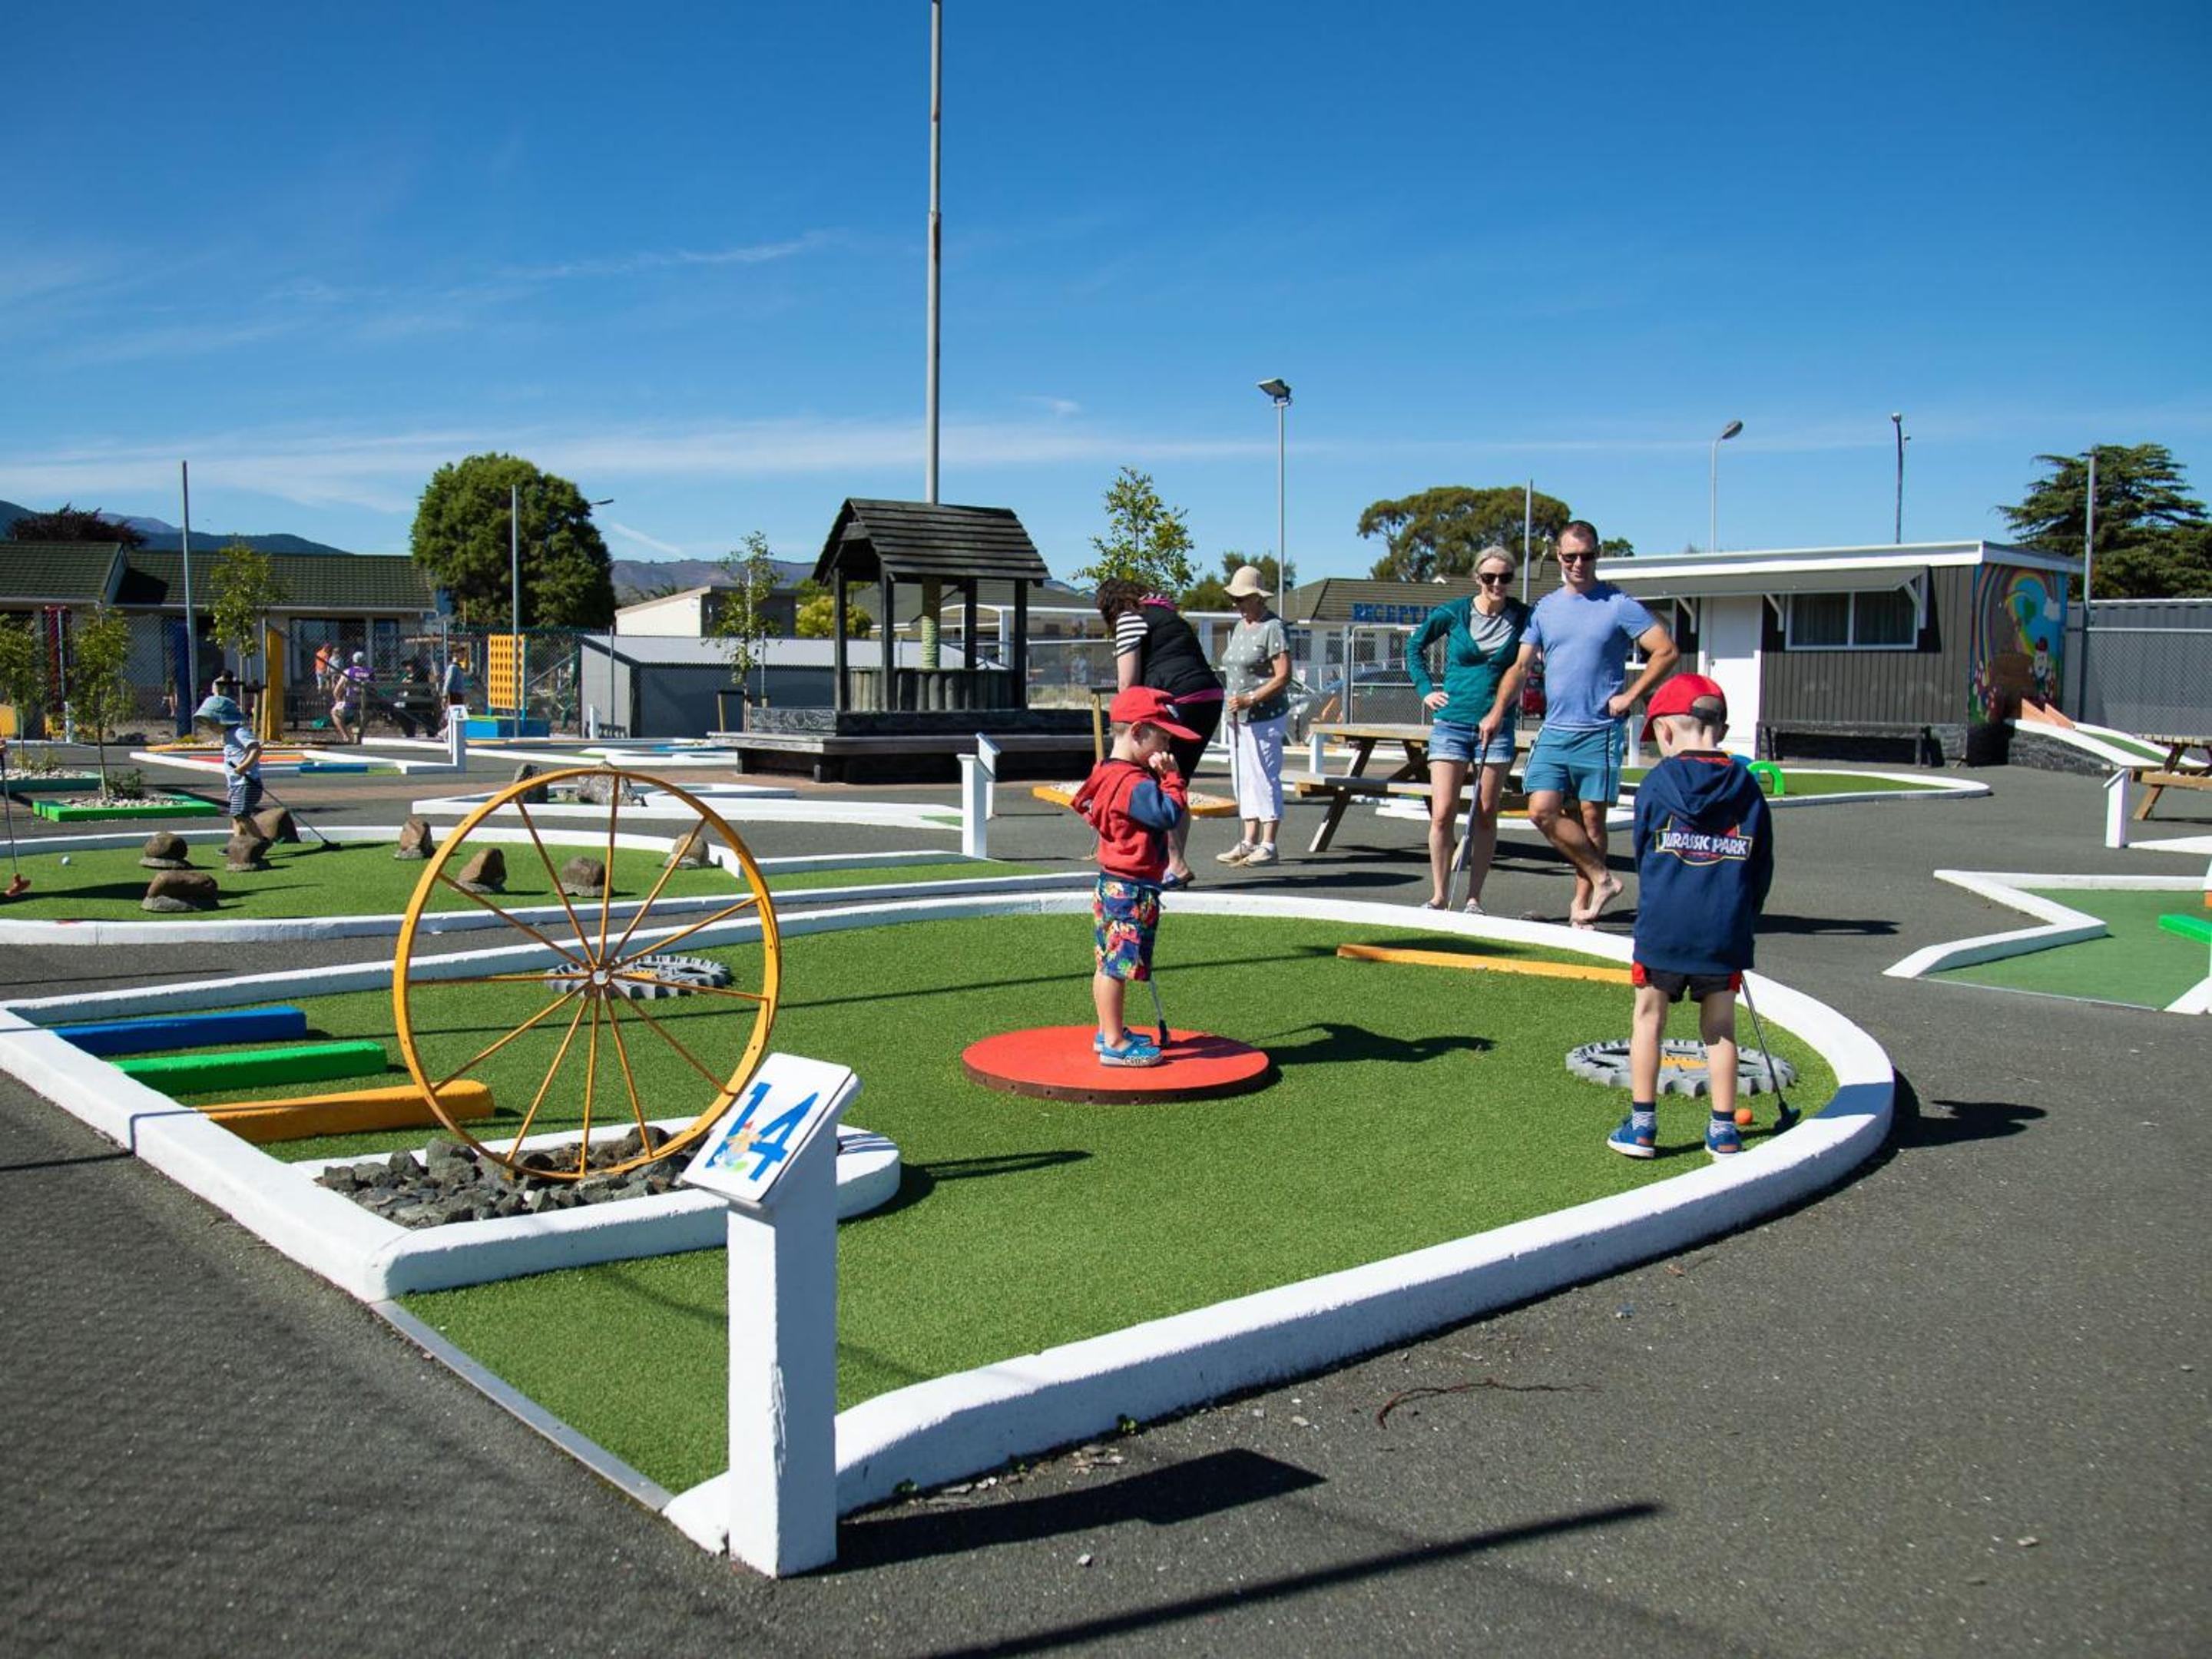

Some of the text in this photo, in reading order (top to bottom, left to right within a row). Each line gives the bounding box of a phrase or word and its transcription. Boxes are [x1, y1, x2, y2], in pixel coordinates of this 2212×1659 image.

[1661, 832, 1747, 854] JURASSIC PARK
[705, 1082, 818, 1181] 14
